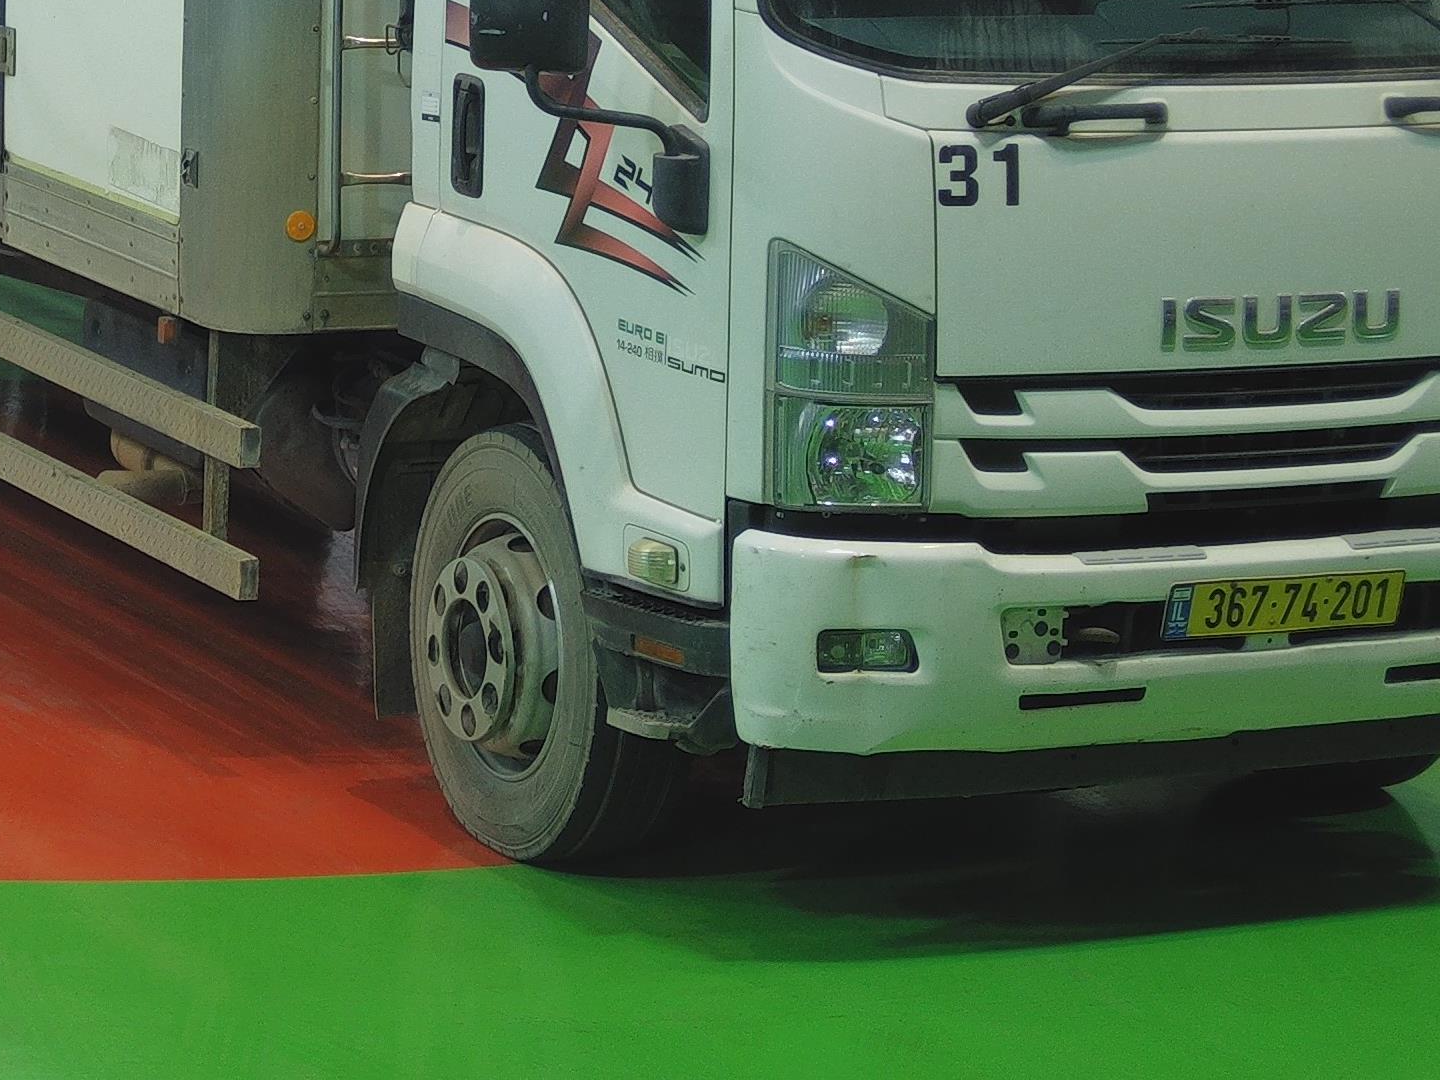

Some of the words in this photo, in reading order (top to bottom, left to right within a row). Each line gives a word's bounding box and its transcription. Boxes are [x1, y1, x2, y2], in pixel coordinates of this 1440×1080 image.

[938, 143, 1020, 207] 31
[617, 318, 653, 341] EURO
[655, 330, 665, 345] 6
[1160, 287, 1401, 353] ISUZU
[616, 338, 643, 358] 14-240
[667, 355, 726, 384] SUMO
[1171, 601, 1185, 622] IL
